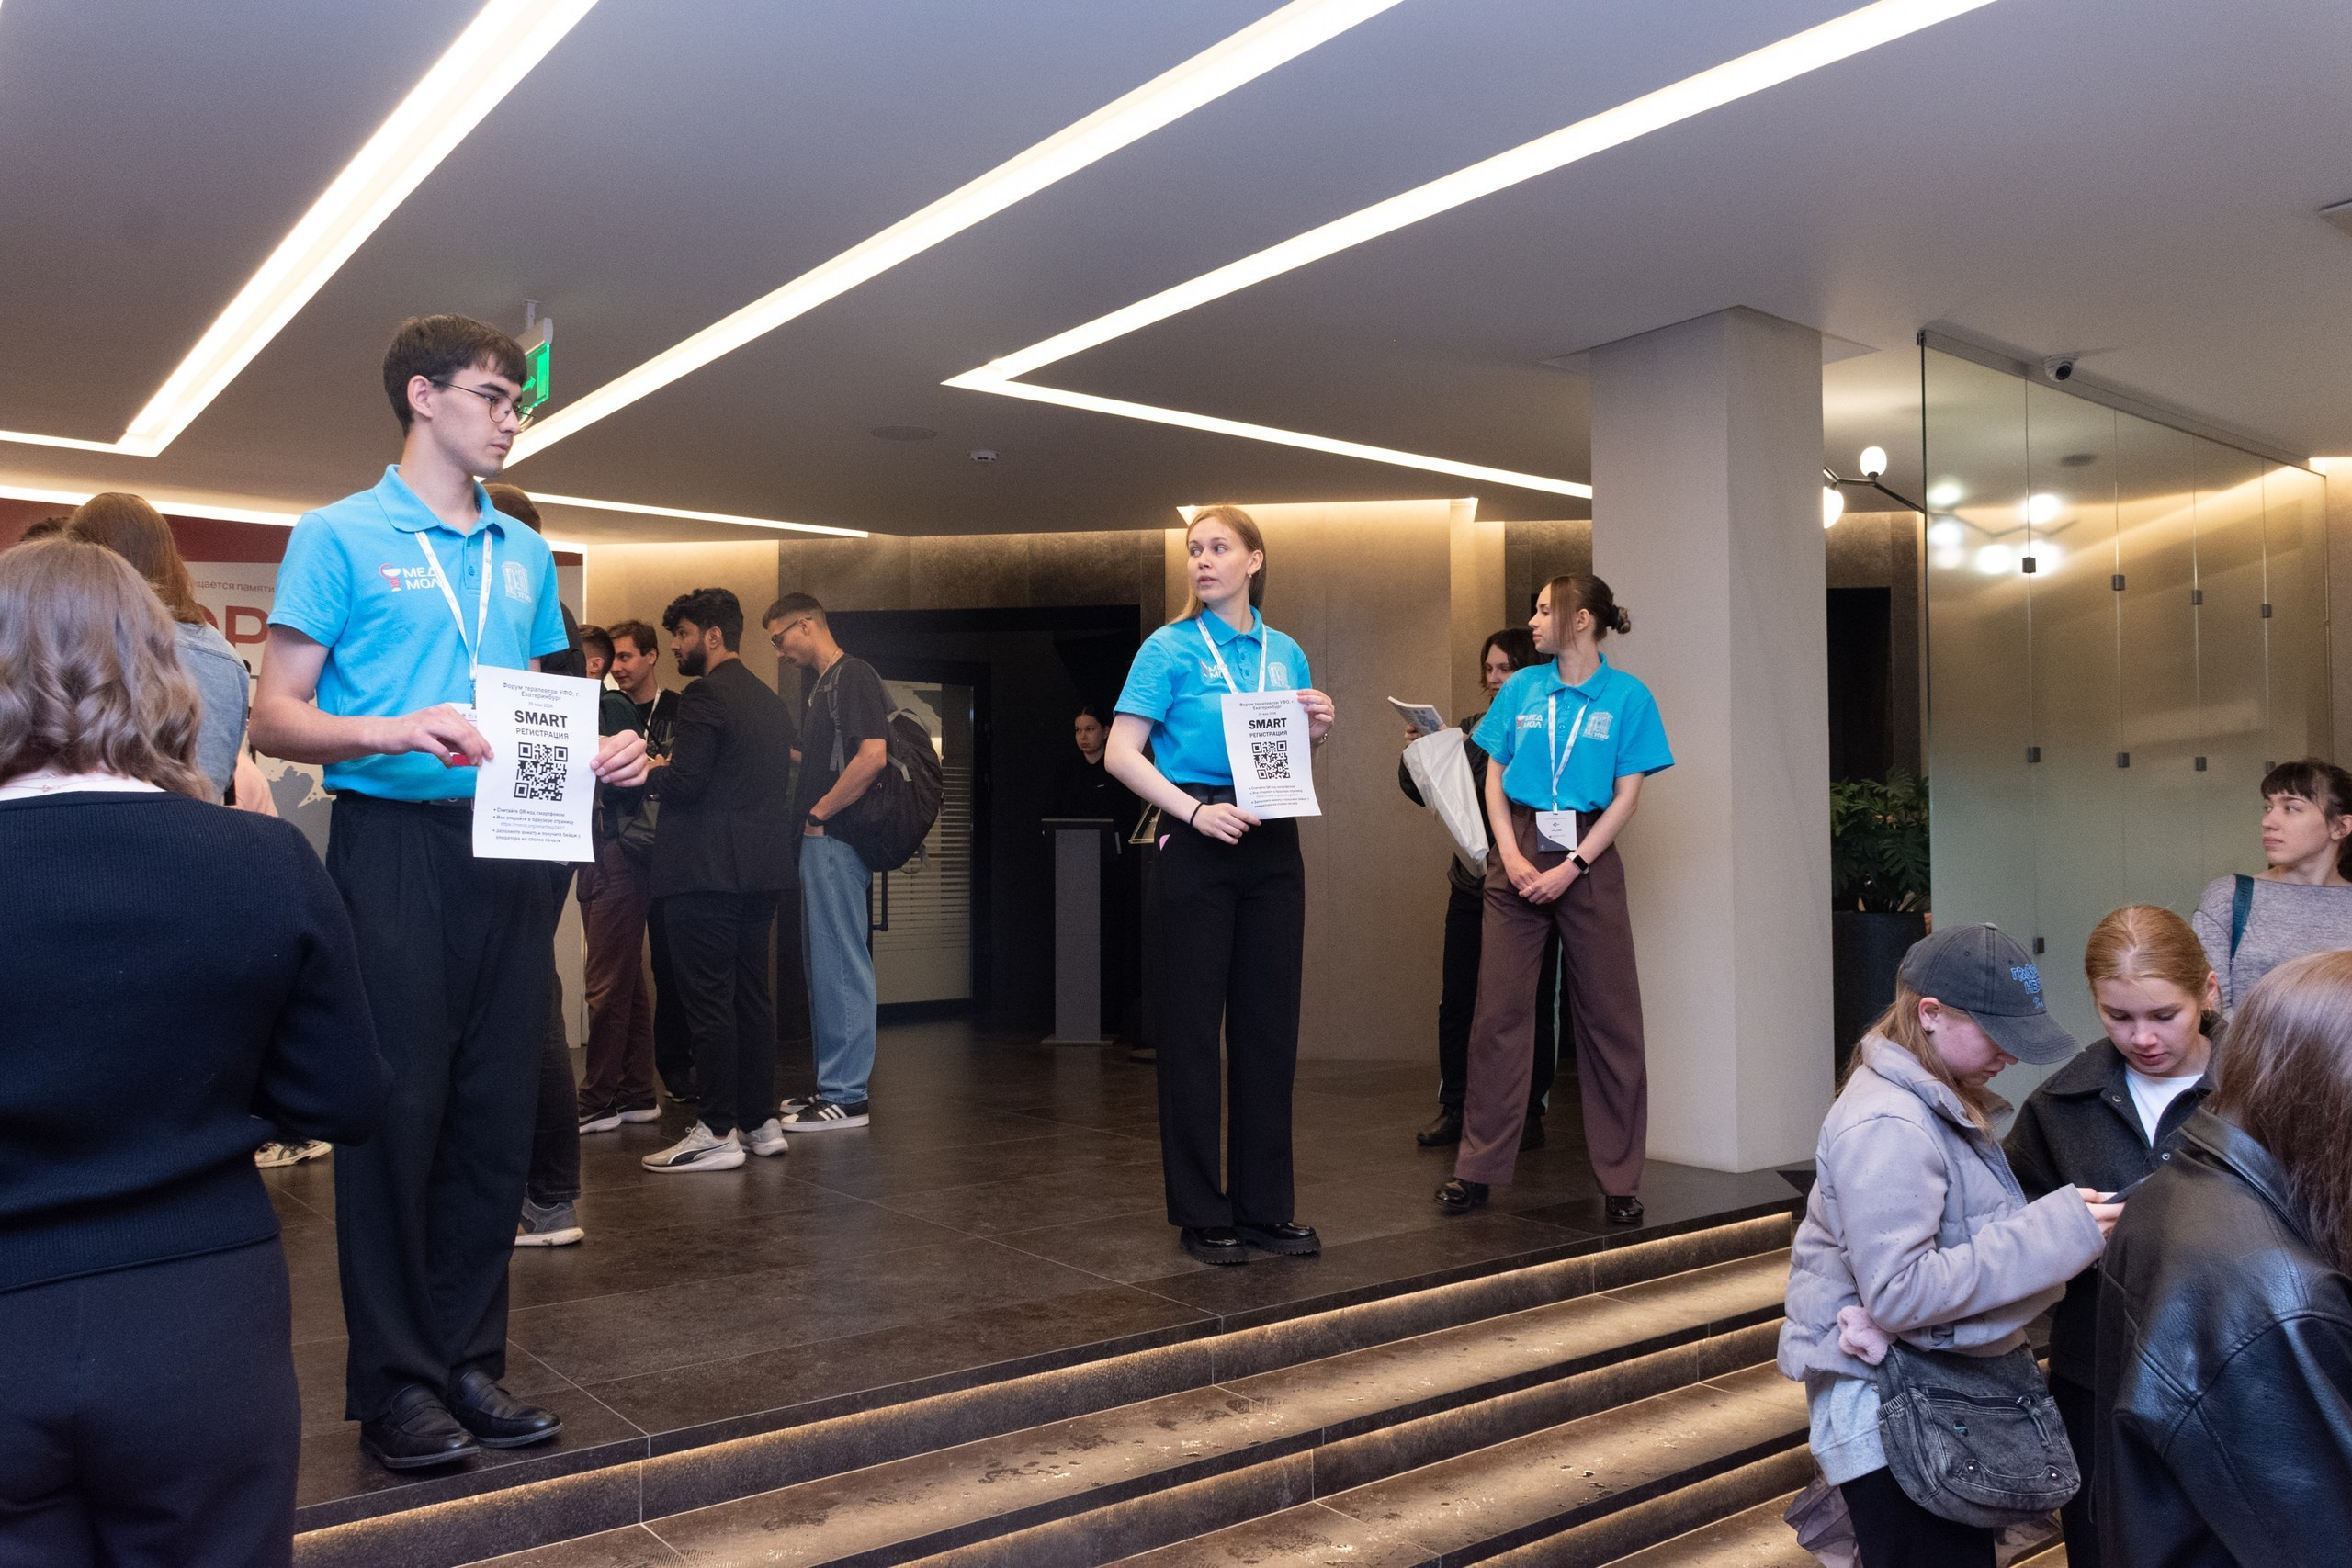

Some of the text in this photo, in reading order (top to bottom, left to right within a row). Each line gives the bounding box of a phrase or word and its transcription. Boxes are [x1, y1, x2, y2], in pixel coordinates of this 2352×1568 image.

[197, 581, 234, 590] щается
[503, 682, 523, 691] Форум
[525, 685, 558, 695] терапевтов
[521, 691, 561, 701] Екатеринбург
[514, 710, 568, 728] SMART
[1249, 717, 1287, 729] SMART
[515, 728, 569, 739] РЕГИСТРАЦИЯ
